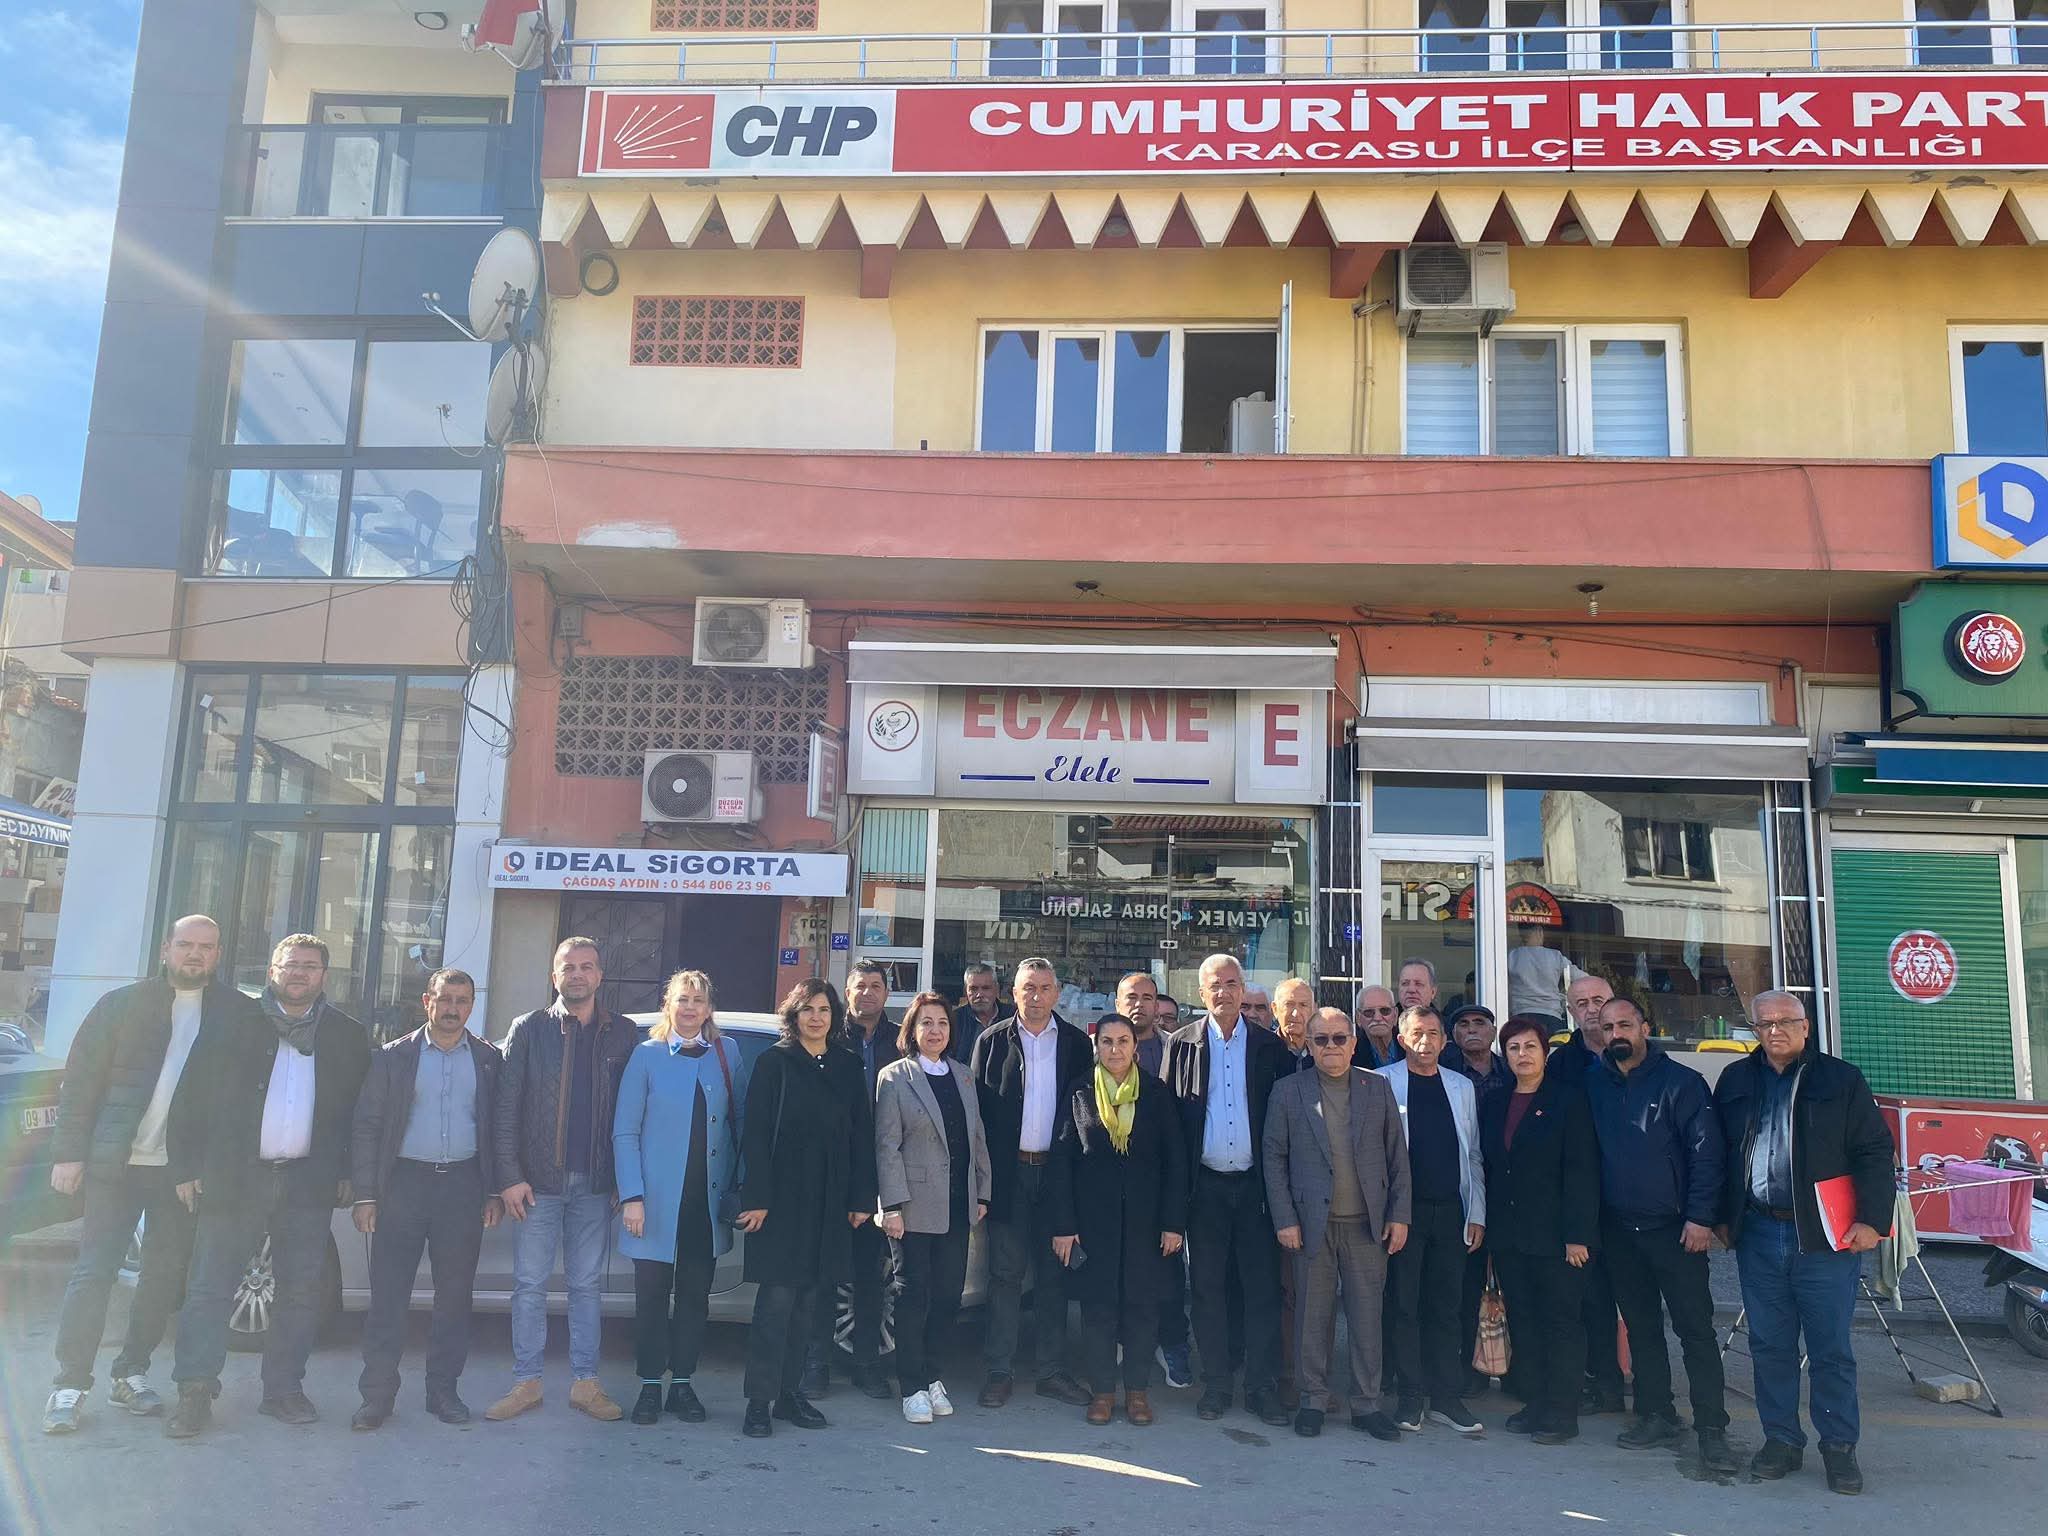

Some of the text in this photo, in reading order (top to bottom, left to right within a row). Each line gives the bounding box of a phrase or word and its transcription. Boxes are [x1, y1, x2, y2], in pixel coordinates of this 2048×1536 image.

[725, 105, 878, 158] CHP
[969, 89, 1547, 136] CUMHURİYET
[1579, 92, 1822, 128] HALK
[1147, 133, 1982, 162] KARACASU İLÇE BAŞKANLIĞI
[963, 685, 1209, 743] ECZANE
[1264, 704, 1299, 766] E
[1044, 755, 1122, 784] Elele
[563, 875, 616, 889] ÇAĞDAŞ
[620, 879, 659, 888] AYDIN
[671, 879, 678, 889] 0
[682, 880, 706, 890] 544
[709, 880, 733, 890] 806
[736, 881, 751, 891] 23
[756, 881, 771, 891] 96
[785, 951, 795, 959] 27
